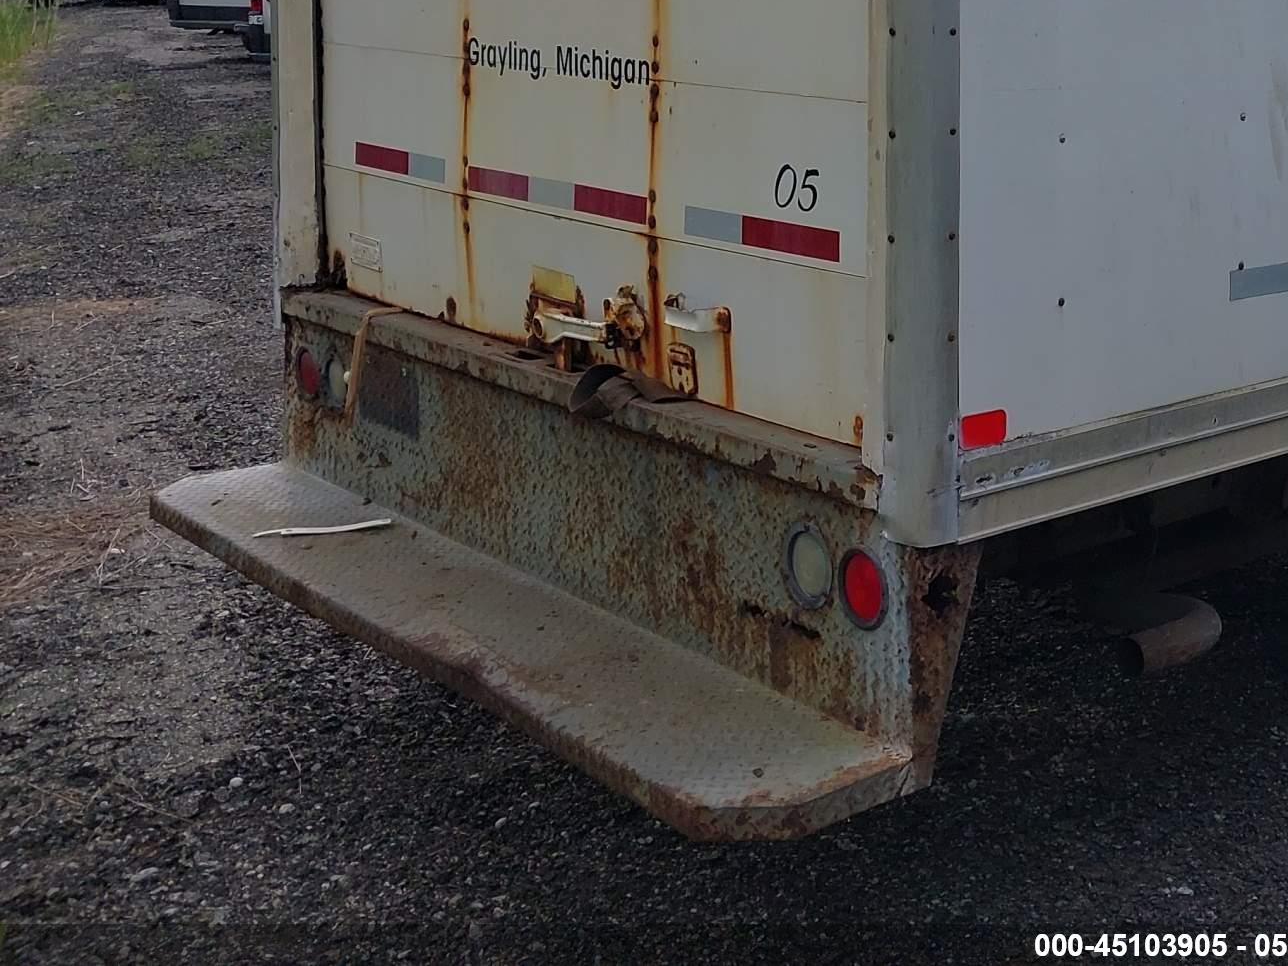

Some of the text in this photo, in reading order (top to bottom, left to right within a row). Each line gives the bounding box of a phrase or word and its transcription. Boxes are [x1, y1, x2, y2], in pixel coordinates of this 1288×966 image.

[468, 36, 650, 90] Grayling, Michigan
[774, 163, 820, 212] 05
